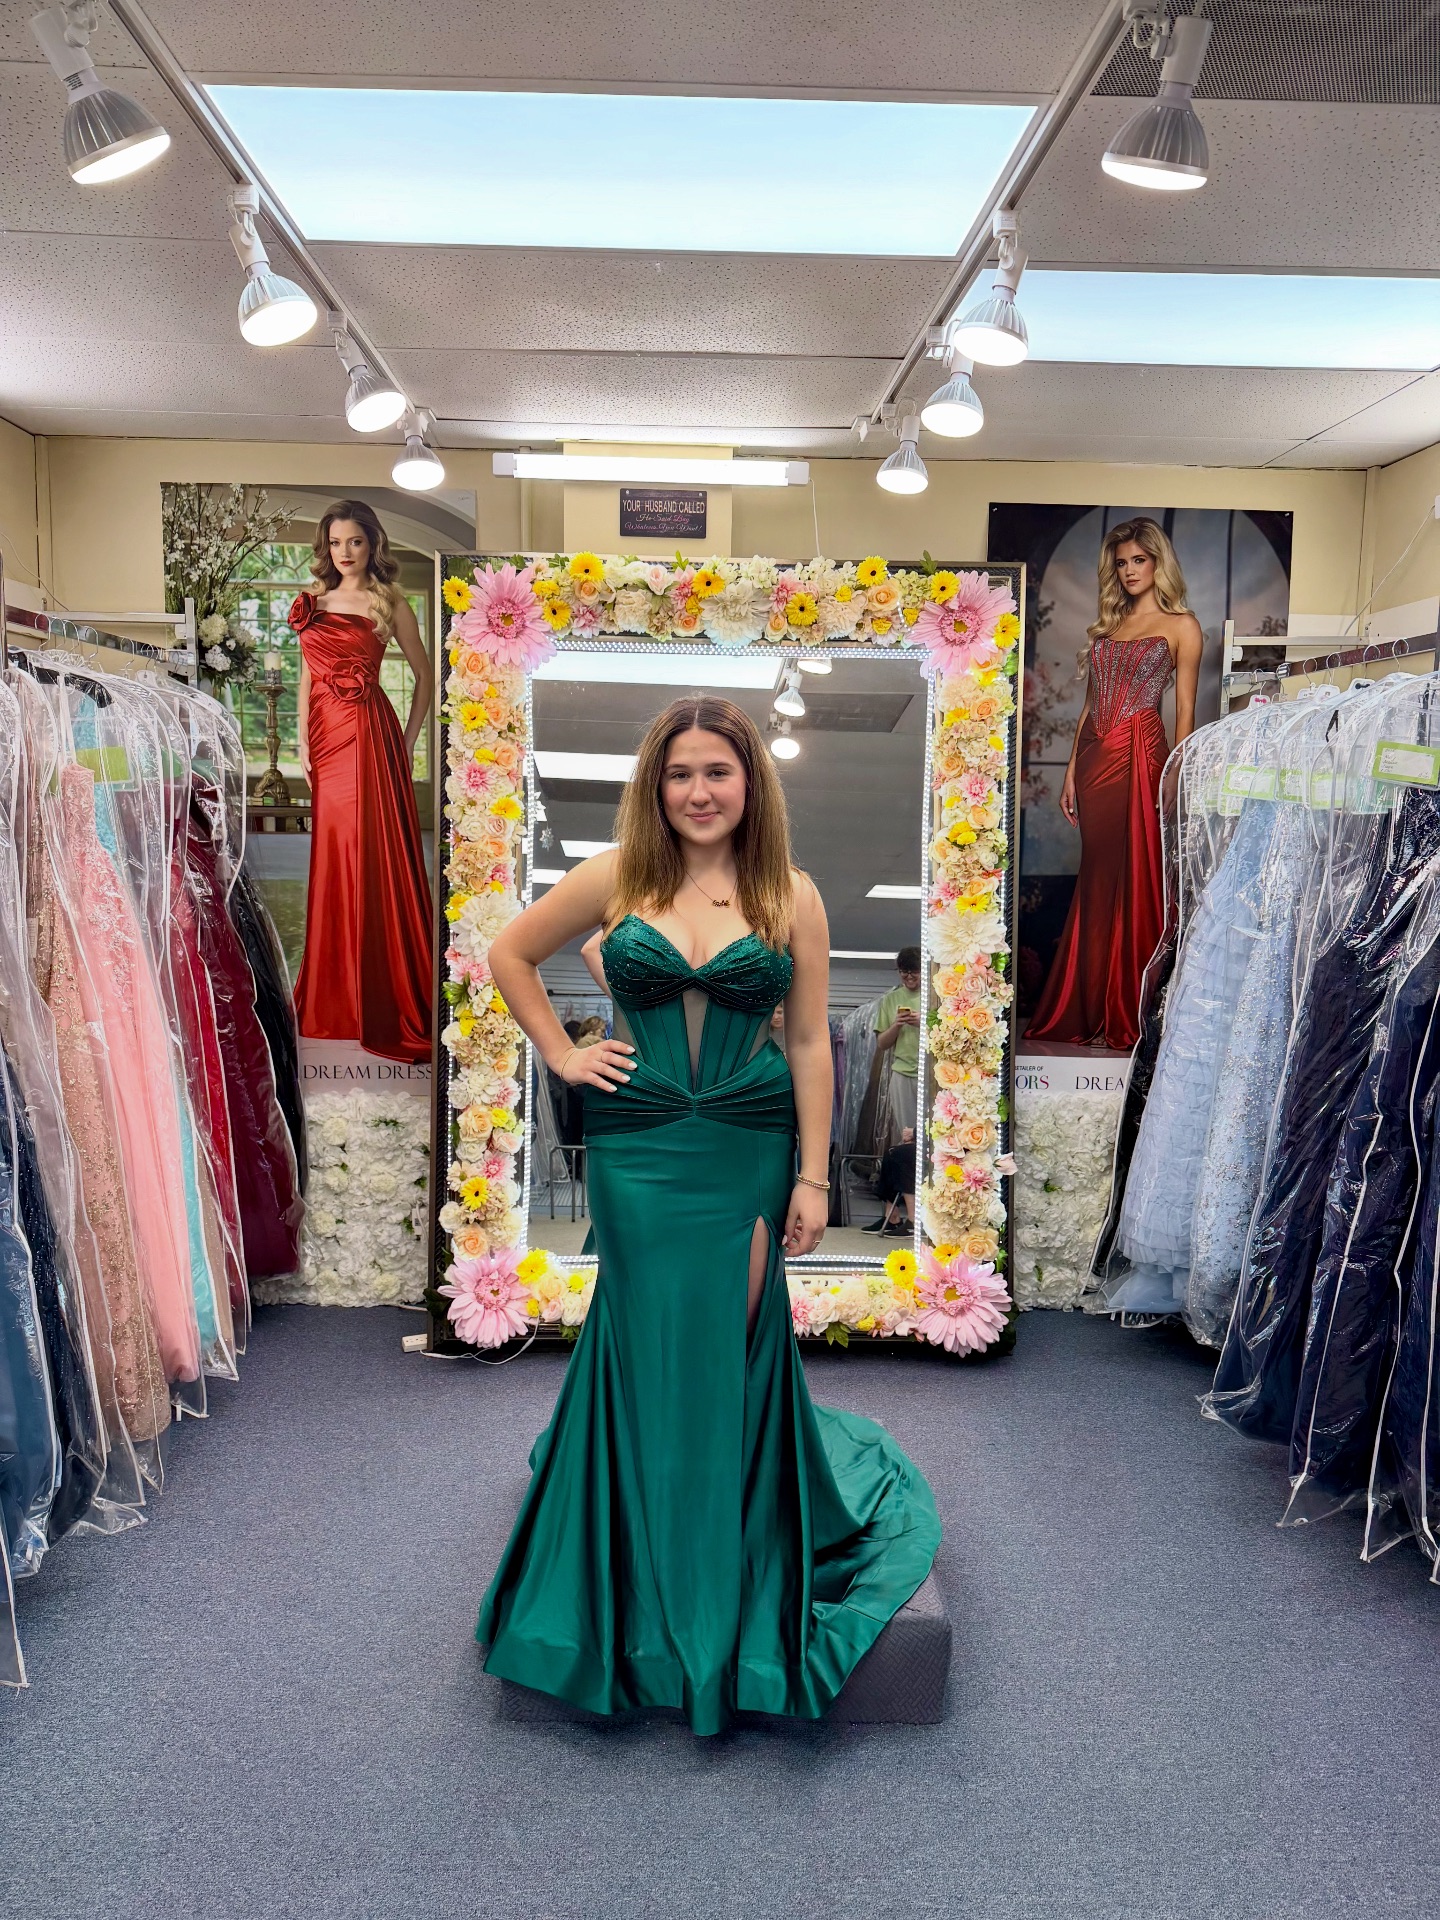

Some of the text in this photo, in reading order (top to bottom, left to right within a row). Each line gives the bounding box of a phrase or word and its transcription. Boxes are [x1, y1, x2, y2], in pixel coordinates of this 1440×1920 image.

[623, 500, 705, 514] YOUR HUSBAND CALLED
[656, 513, 672, 522] Said
[303, 1064, 371, 1080] DREAM
[1015, 1074, 1050, 1090] ORS
[1075, 1076, 1124, 1091] DREA
